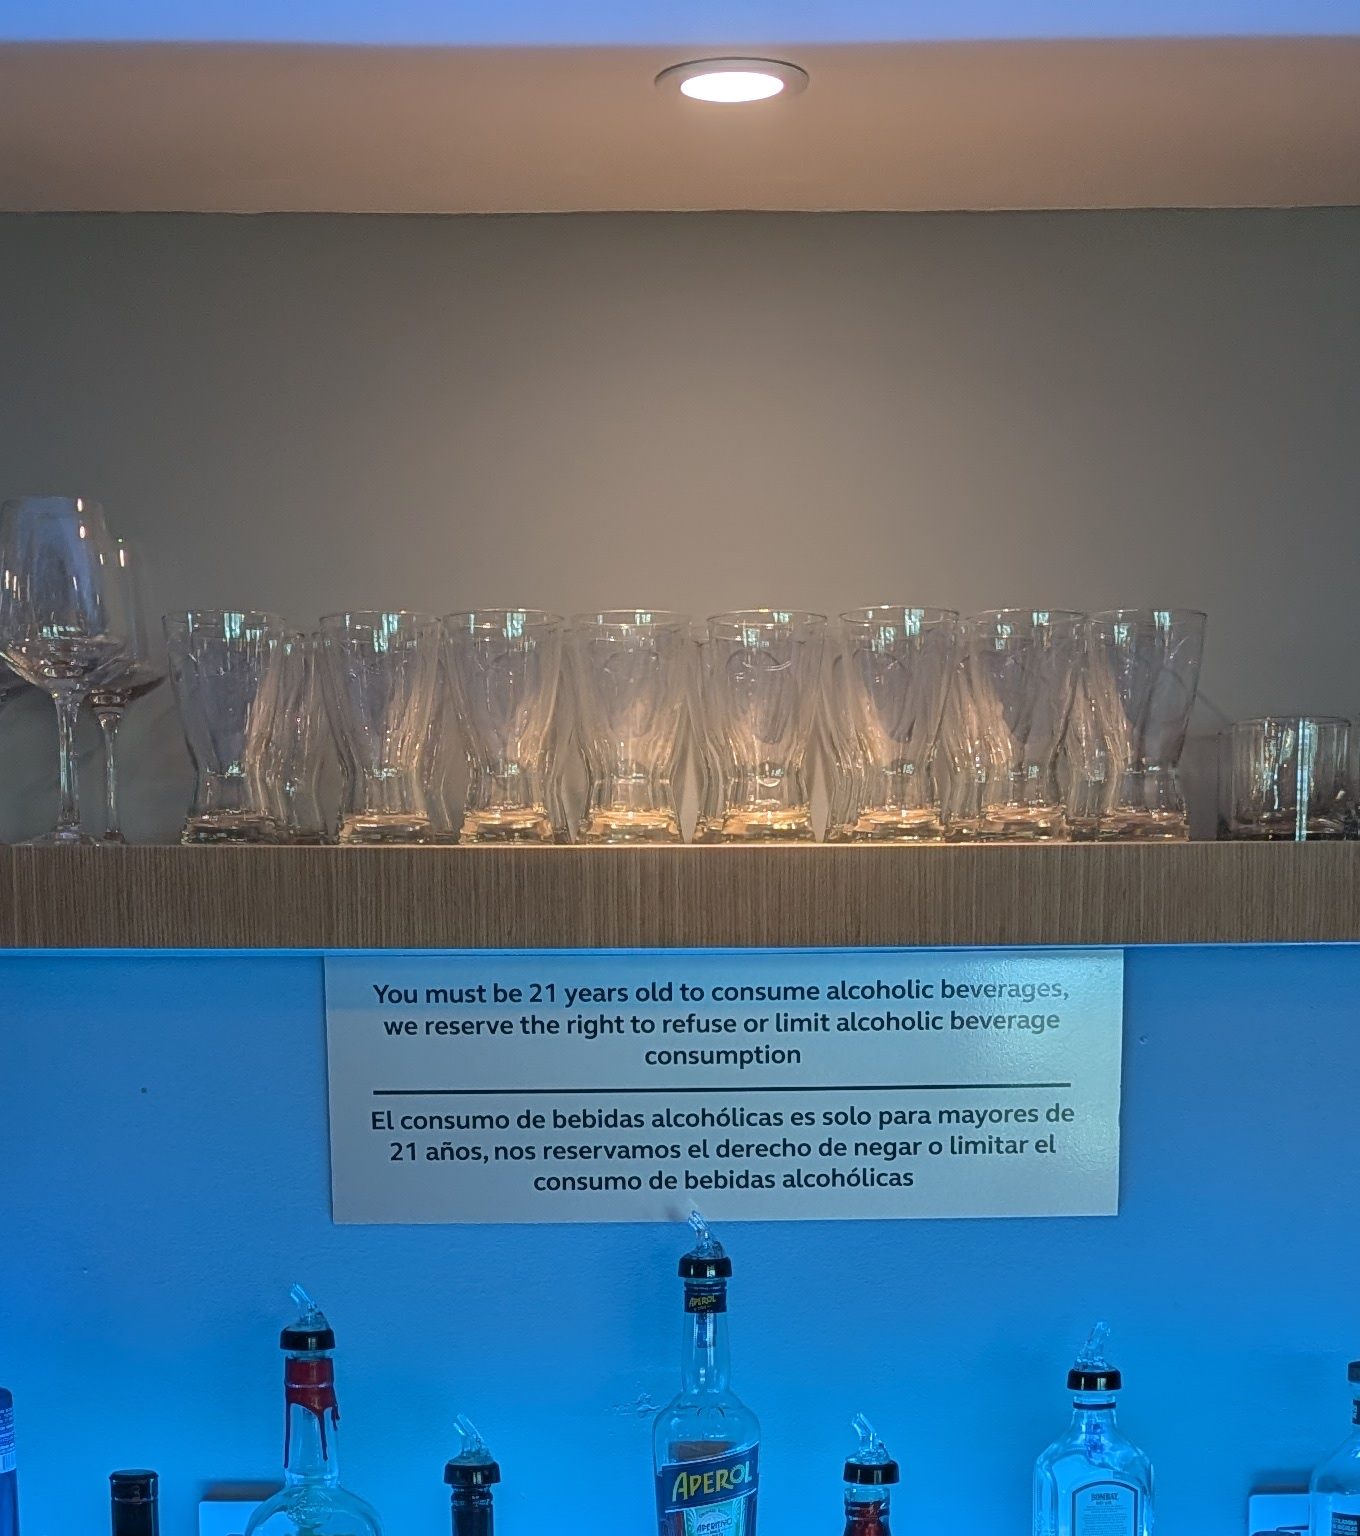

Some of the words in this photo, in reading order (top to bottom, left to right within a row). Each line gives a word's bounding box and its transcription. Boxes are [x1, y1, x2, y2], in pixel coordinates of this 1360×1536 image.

[372, 984, 417, 1004] You
[426, 985, 486, 1003] must
[494, 983, 522, 1003] be
[530, 983, 554, 1002] 21
[564, 988, 629, 1010] years
[636, 982, 672, 1002] old
[679, 984, 704, 1001] to
[712, 985, 821, 1001] consume
[827, 979, 934, 1000] alcoholic
[940, 978, 1069, 1005] beverages,
[384, 1021, 418, 1035] we
[426, 1020, 513, 1035] reserve
[520, 1015, 560, 1034] the
[568, 1014, 624, 1039] right
[630, 1016, 655, 1033] to
[663, 1013, 736, 1033] refuse
[744, 1018, 769, 1032] or
[776, 1012, 830, 1032] limit
[837, 1011, 943, 1031] alcoholic
[951, 1009, 1061, 1036] beverage
[645, 1044, 800, 1068] consumption
[372, 1110, 394, 1130] El
[401, 1115, 509, 1130] consumo
[517, 1109, 545, 1129] de
[553, 1109, 644, 1128] bebidas
[652, 1107, 783, 1127] alcohólicas
[791, 1112, 815, 1126] es
[823, 1106, 871, 1125] solo
[879, 1110, 932, 1130] para
[939, 1108, 1038, 1130] mayores
[1046, 1103, 1074, 1122] de
[391, 1142, 415, 1160] 21
[426, 1142, 488, 1164] años,
[495, 1146, 536, 1160] nos
[544, 1145, 681, 1159] reservamos
[688, 1139, 710, 1158] el
[716, 1138, 811, 1158] derecho
[819, 1137, 847, 1156] de
[854, 1141, 922, 1162] negar
[929, 1141, 942, 1155] o
[951, 1135, 1029, 1154] limitar
[1035, 1134, 1056, 1153] el
[534, 1176, 642, 1191] consumo
[649, 1170, 677, 1189] de
[685, 1169, 775, 1189] bebidas
[783, 1167, 913, 1188] alcohólicas
[671, 1460, 753, 1502] APEROL
